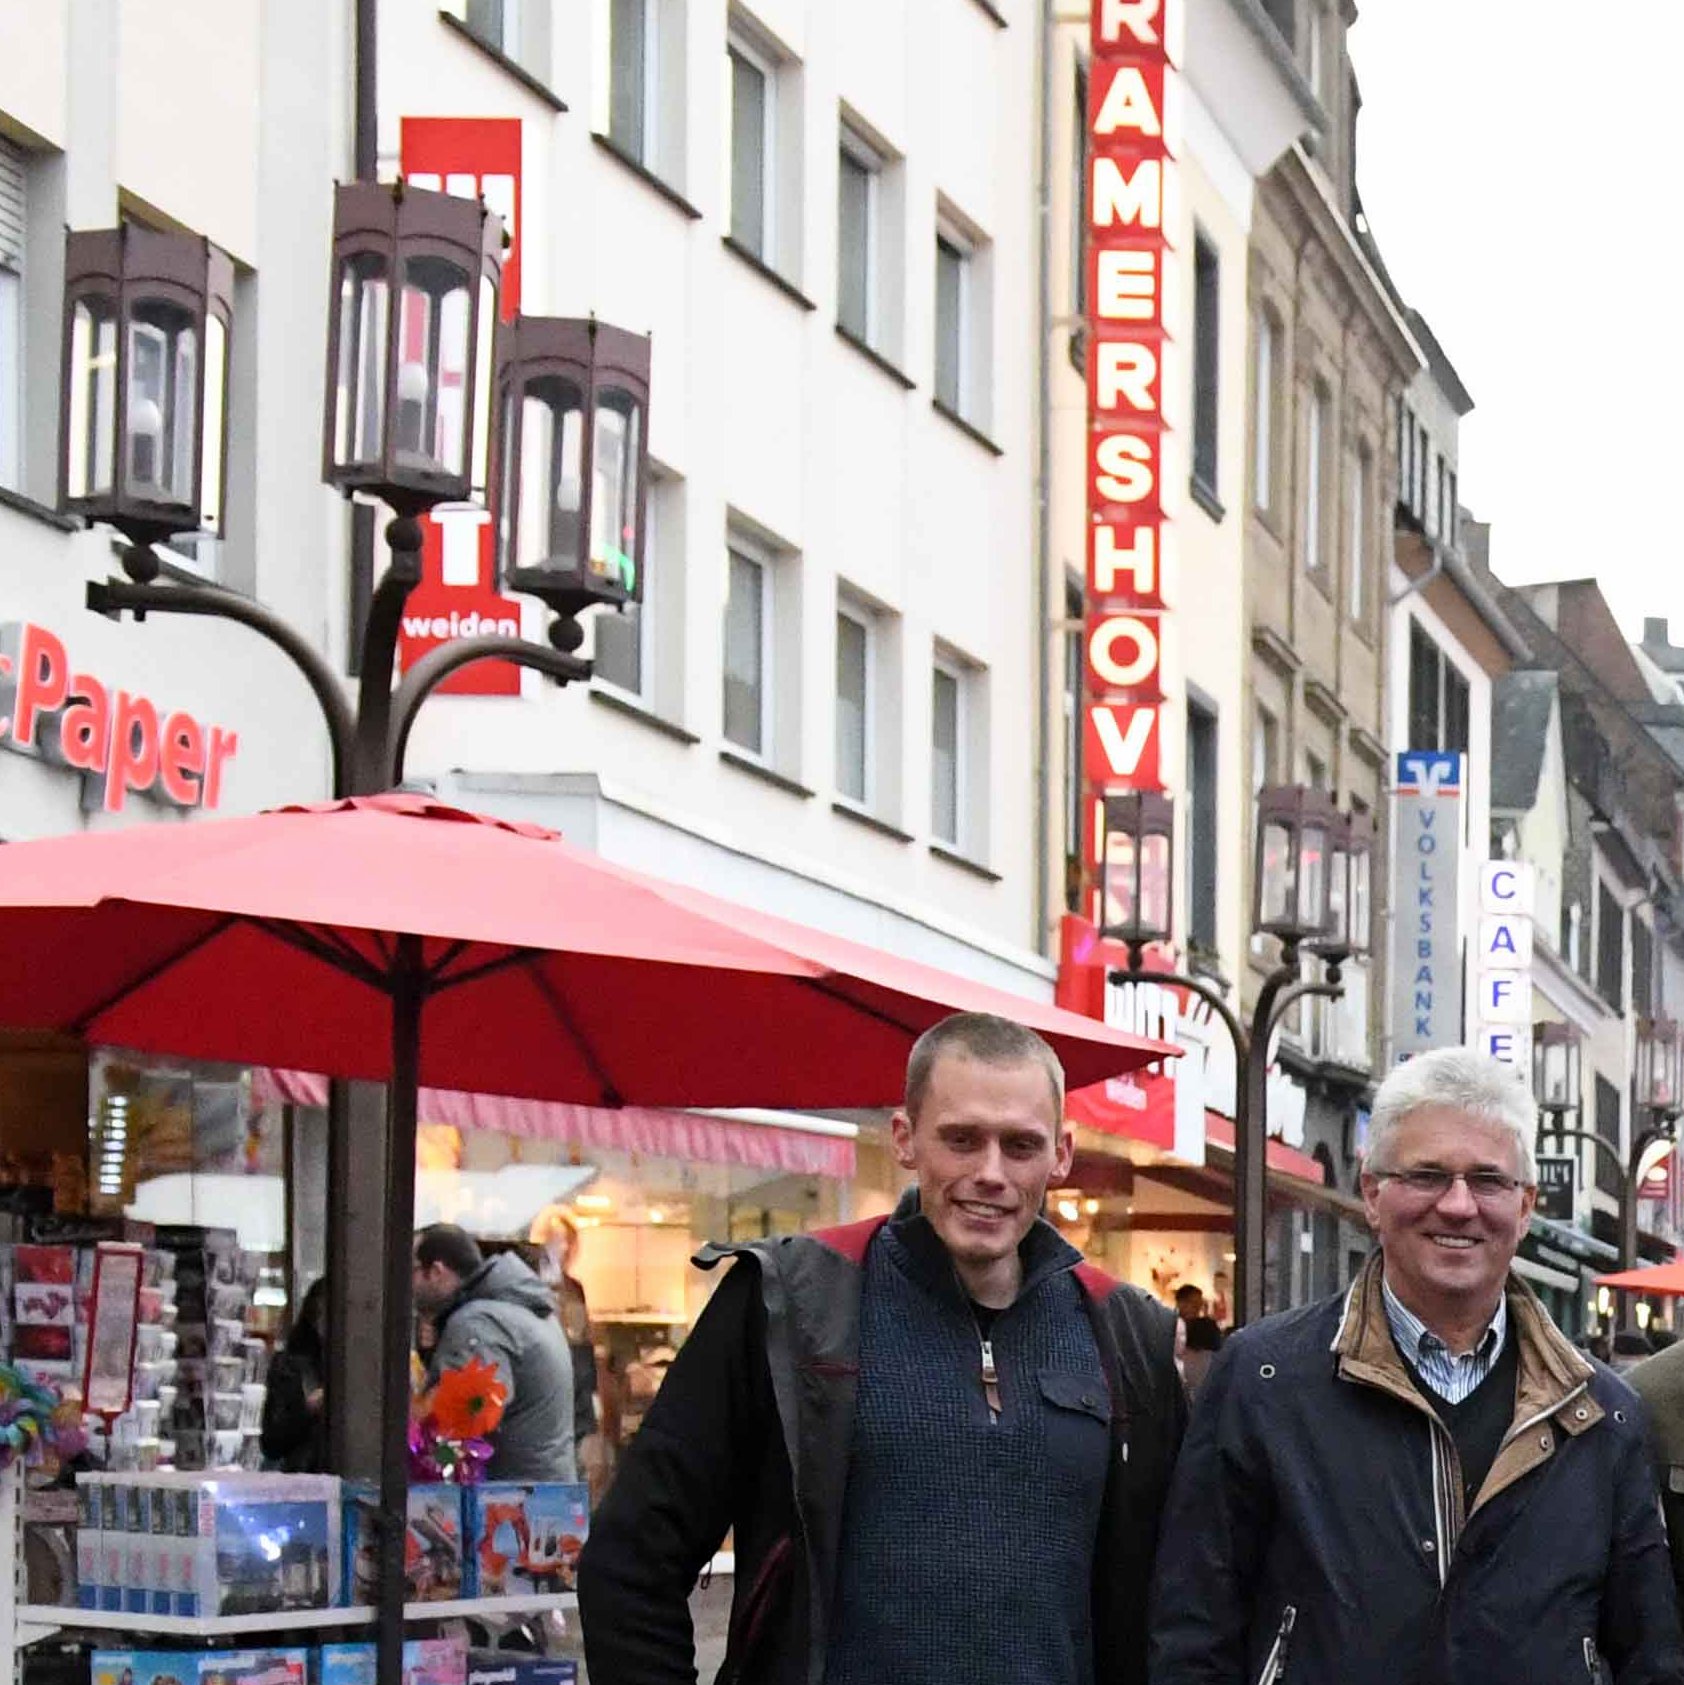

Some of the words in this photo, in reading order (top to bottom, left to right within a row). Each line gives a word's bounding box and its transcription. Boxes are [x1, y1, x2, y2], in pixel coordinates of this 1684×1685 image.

[0, 622, 239, 813] Paper
[402, 610, 519, 638] weiden
[1414, 810, 1437, 1037] VOLKSBANK
[1490, 871, 1517, 1063] CAFE
